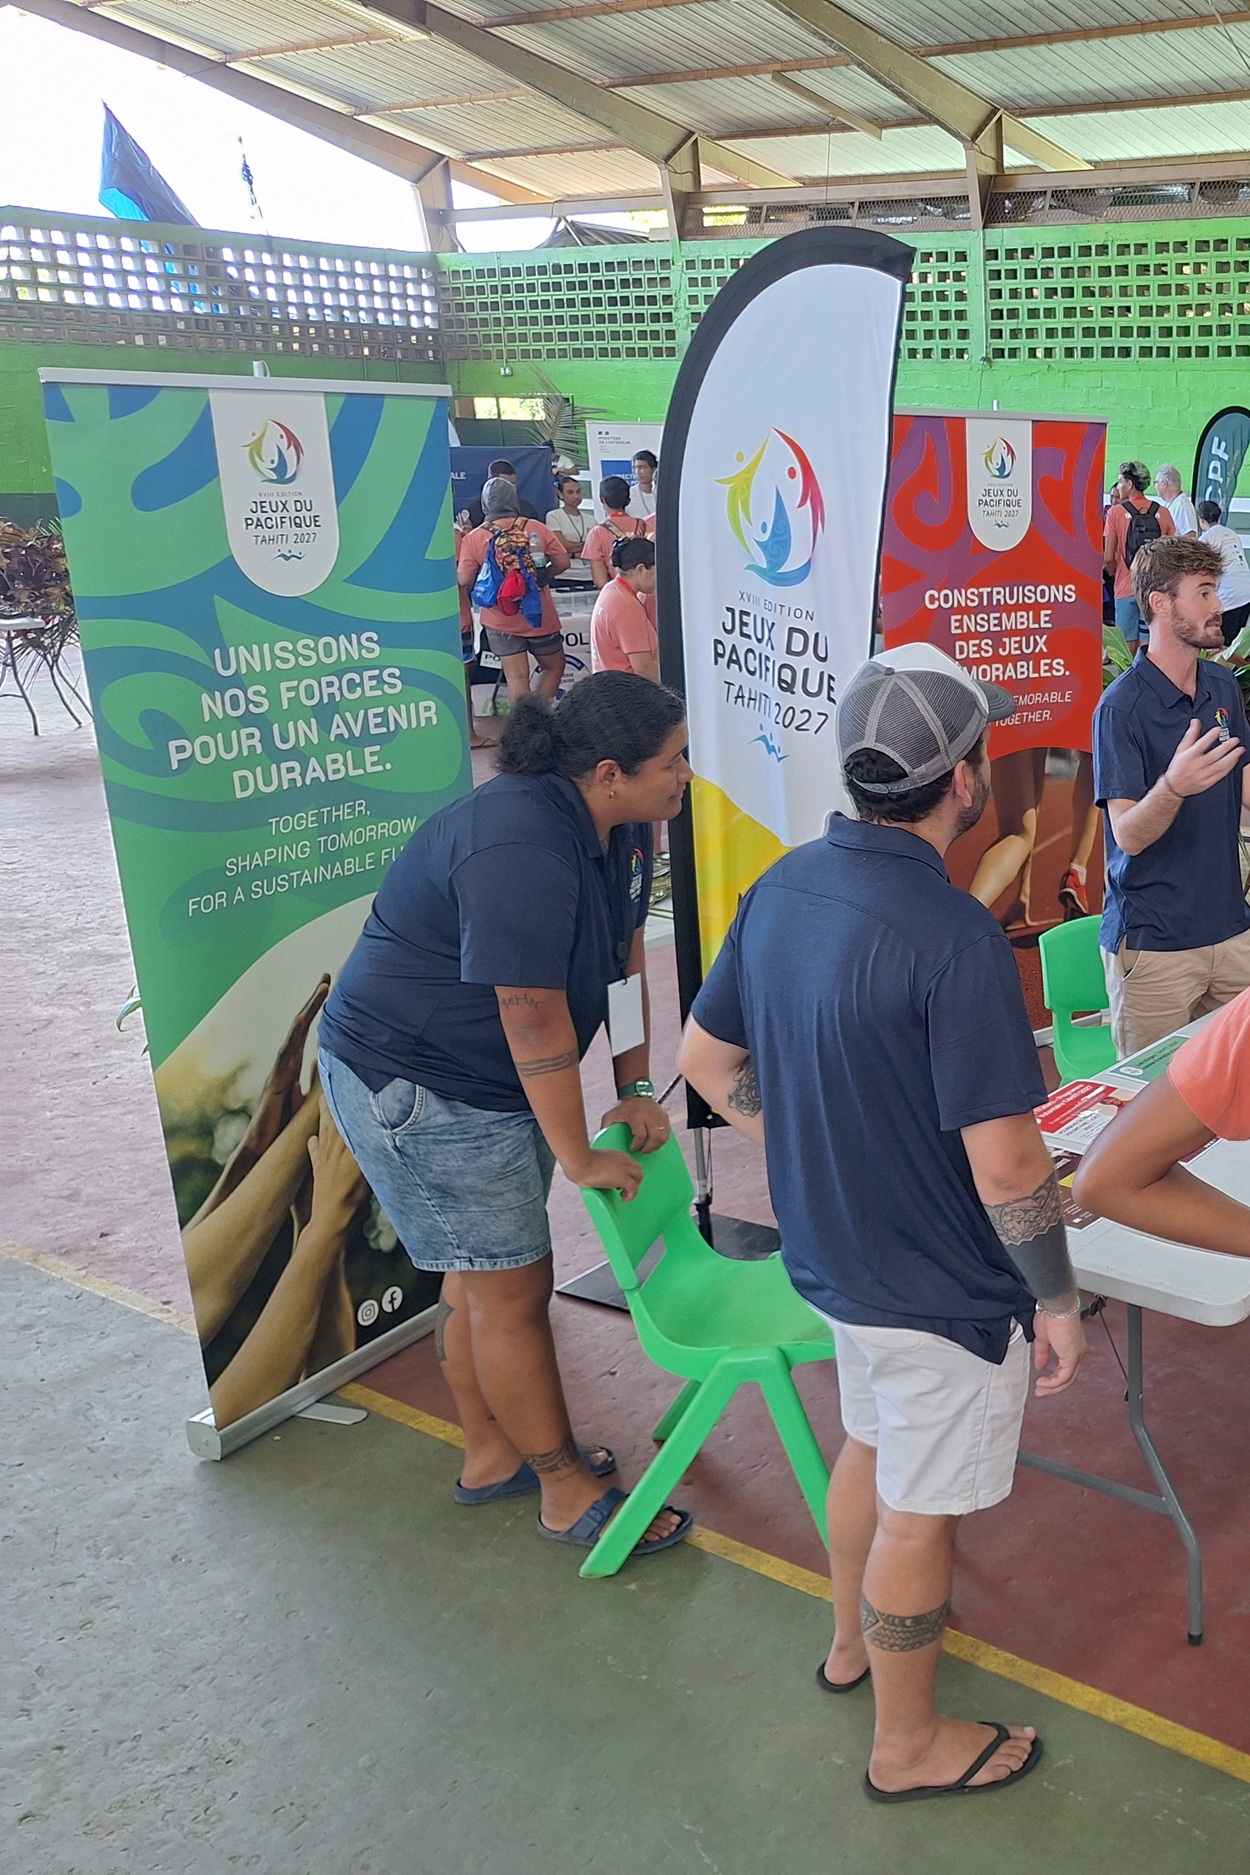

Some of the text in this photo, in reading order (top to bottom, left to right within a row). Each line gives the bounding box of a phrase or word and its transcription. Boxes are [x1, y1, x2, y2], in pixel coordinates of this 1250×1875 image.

[250, 499, 313, 514] JEUX DU
[977, 498, 1022, 508] PACIFIQUE
[981, 488, 1019, 498] JEUX DU
[244, 515, 322, 530] PACIFIQUE
[982, 510, 1019, 518] TAHITI 2027
[253, 532, 317, 546] TAHITI 2027
[739, 590, 814, 622] XVIII EDITION
[924, 584, 1076, 609] CONSTRUISONS
[722, 606, 829, 663] JEUX DU
[950, 610, 1052, 634] ENSEMBLE
[213, 631, 381, 677] UNISSONS
[955, 635, 1047, 660] DES JEUX
[713, 638, 837, 706] PACIFIQUE
[956, 659, 1070, 682] MORABLES.
[201, 667, 402, 722] NOS FORCES
[723, 680, 829, 735] TAHITI 2027
[1014, 690, 1073, 706] EMORABLE
[168, 700, 438, 770] POUR UN AVENIR
[232, 745, 392, 799] DURABLE.
[268, 799, 371, 835] TOGETHER,
[225, 816, 417, 877] SHAPING TOMORROW
[188, 890, 227, 917] FOR
[233, 886, 245, 905] A
[250, 852, 375, 899] SUSTAINABLE
